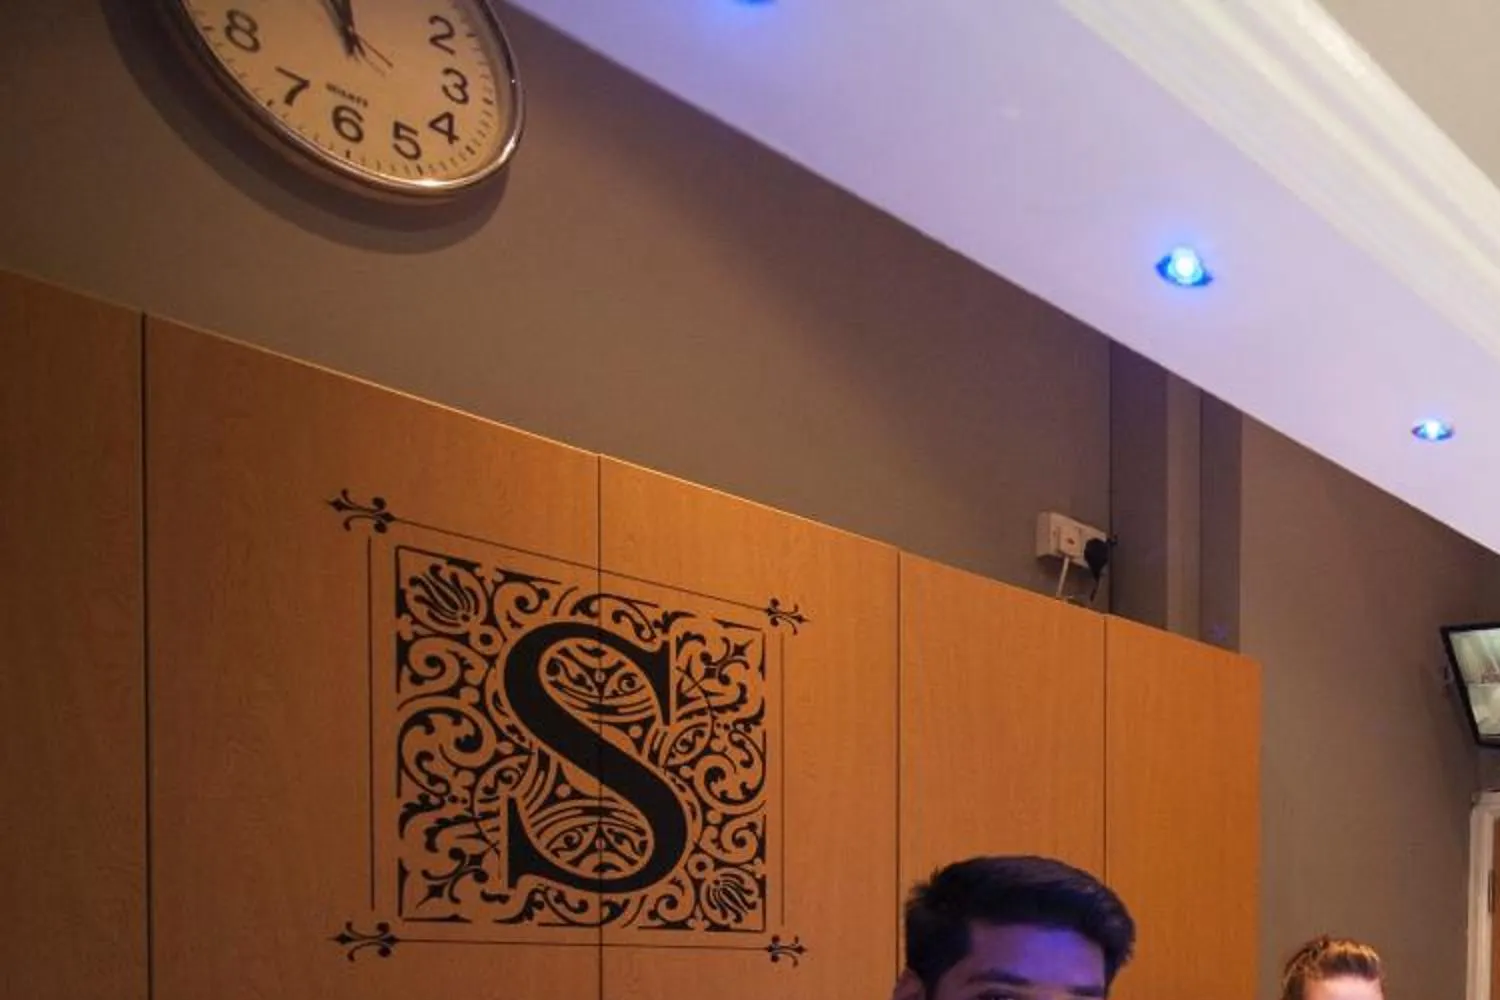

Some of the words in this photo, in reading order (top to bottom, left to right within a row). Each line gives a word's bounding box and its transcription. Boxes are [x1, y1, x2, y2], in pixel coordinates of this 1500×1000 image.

[224, 9, 261, 52] 8
[428, 15, 455, 55] 2
[275, 66, 310, 106] 7
[442, 67, 469, 105] 3
[332, 105, 364, 144] 6
[392, 121, 421, 160] 5
[429, 111, 460, 145] 4
[503, 619, 689, 893] S
